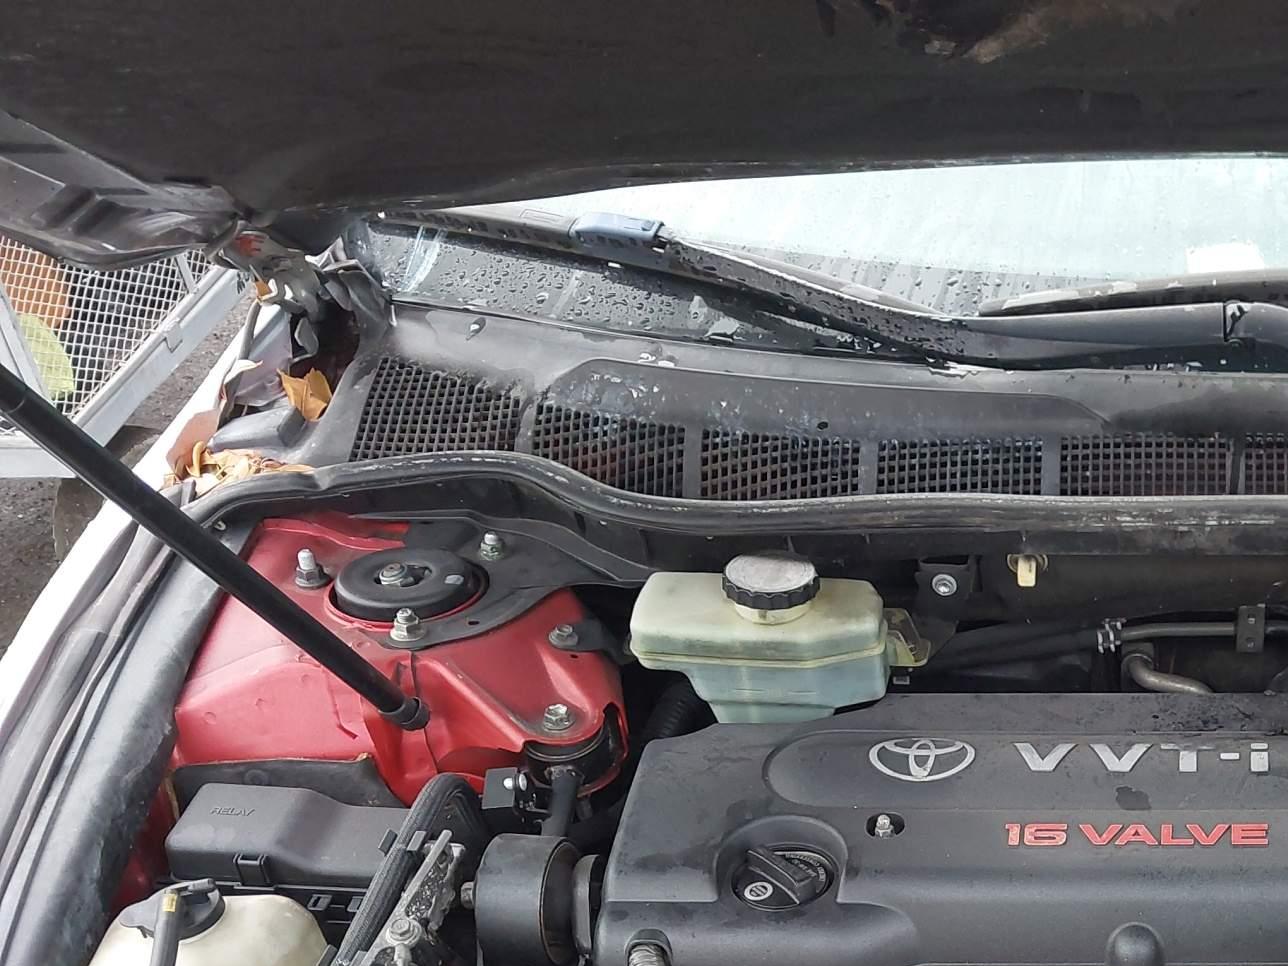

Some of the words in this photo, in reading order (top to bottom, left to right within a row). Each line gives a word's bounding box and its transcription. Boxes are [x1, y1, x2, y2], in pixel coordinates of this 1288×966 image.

[1012, 741, 1270, 773] VVT-i
[1004, 822, 1068, 846] 16
[1078, 822, 1270, 846] VALVE
